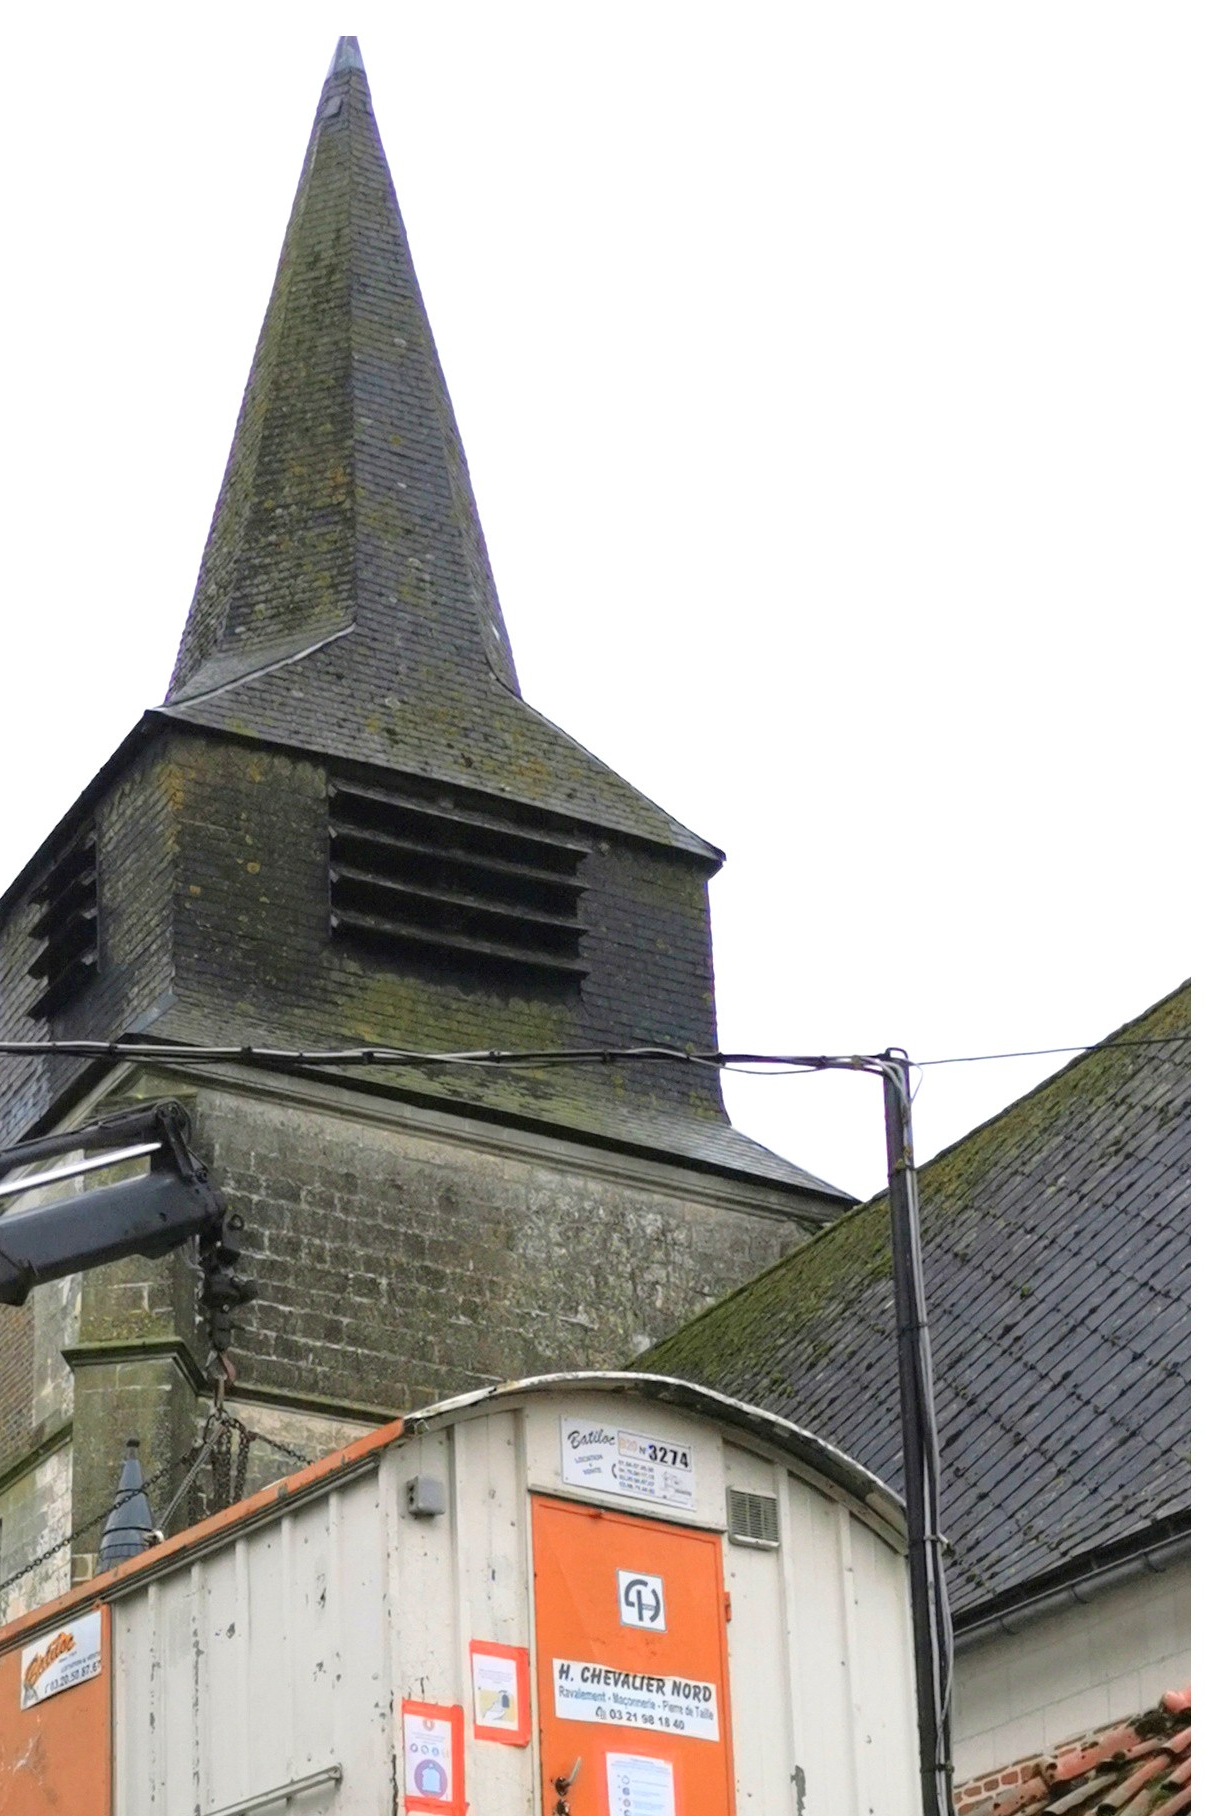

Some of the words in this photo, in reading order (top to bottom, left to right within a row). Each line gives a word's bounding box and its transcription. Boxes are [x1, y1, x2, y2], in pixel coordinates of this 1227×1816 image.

[568, 1429, 616, 1449] Batiloc
[649, 1444, 690, 1468] 3274
[558, 1662, 575, 1682] H.
[580, 1666, 667, 1697] CHEVALIER
[671, 1680, 713, 1704] NORD
[558, 1685, 607, 1703] Ravalement
[684, 1705, 694, 1718] de
[695, 1705, 714, 1721] Taille
[609, 1707, 623, 1721] 03
[626, 1711, 638, 1723] 21
[641, 1714, 654, 1726] 98
[658, 1716, 670, 1729] 18
[673, 1719, 685, 1731] 40
